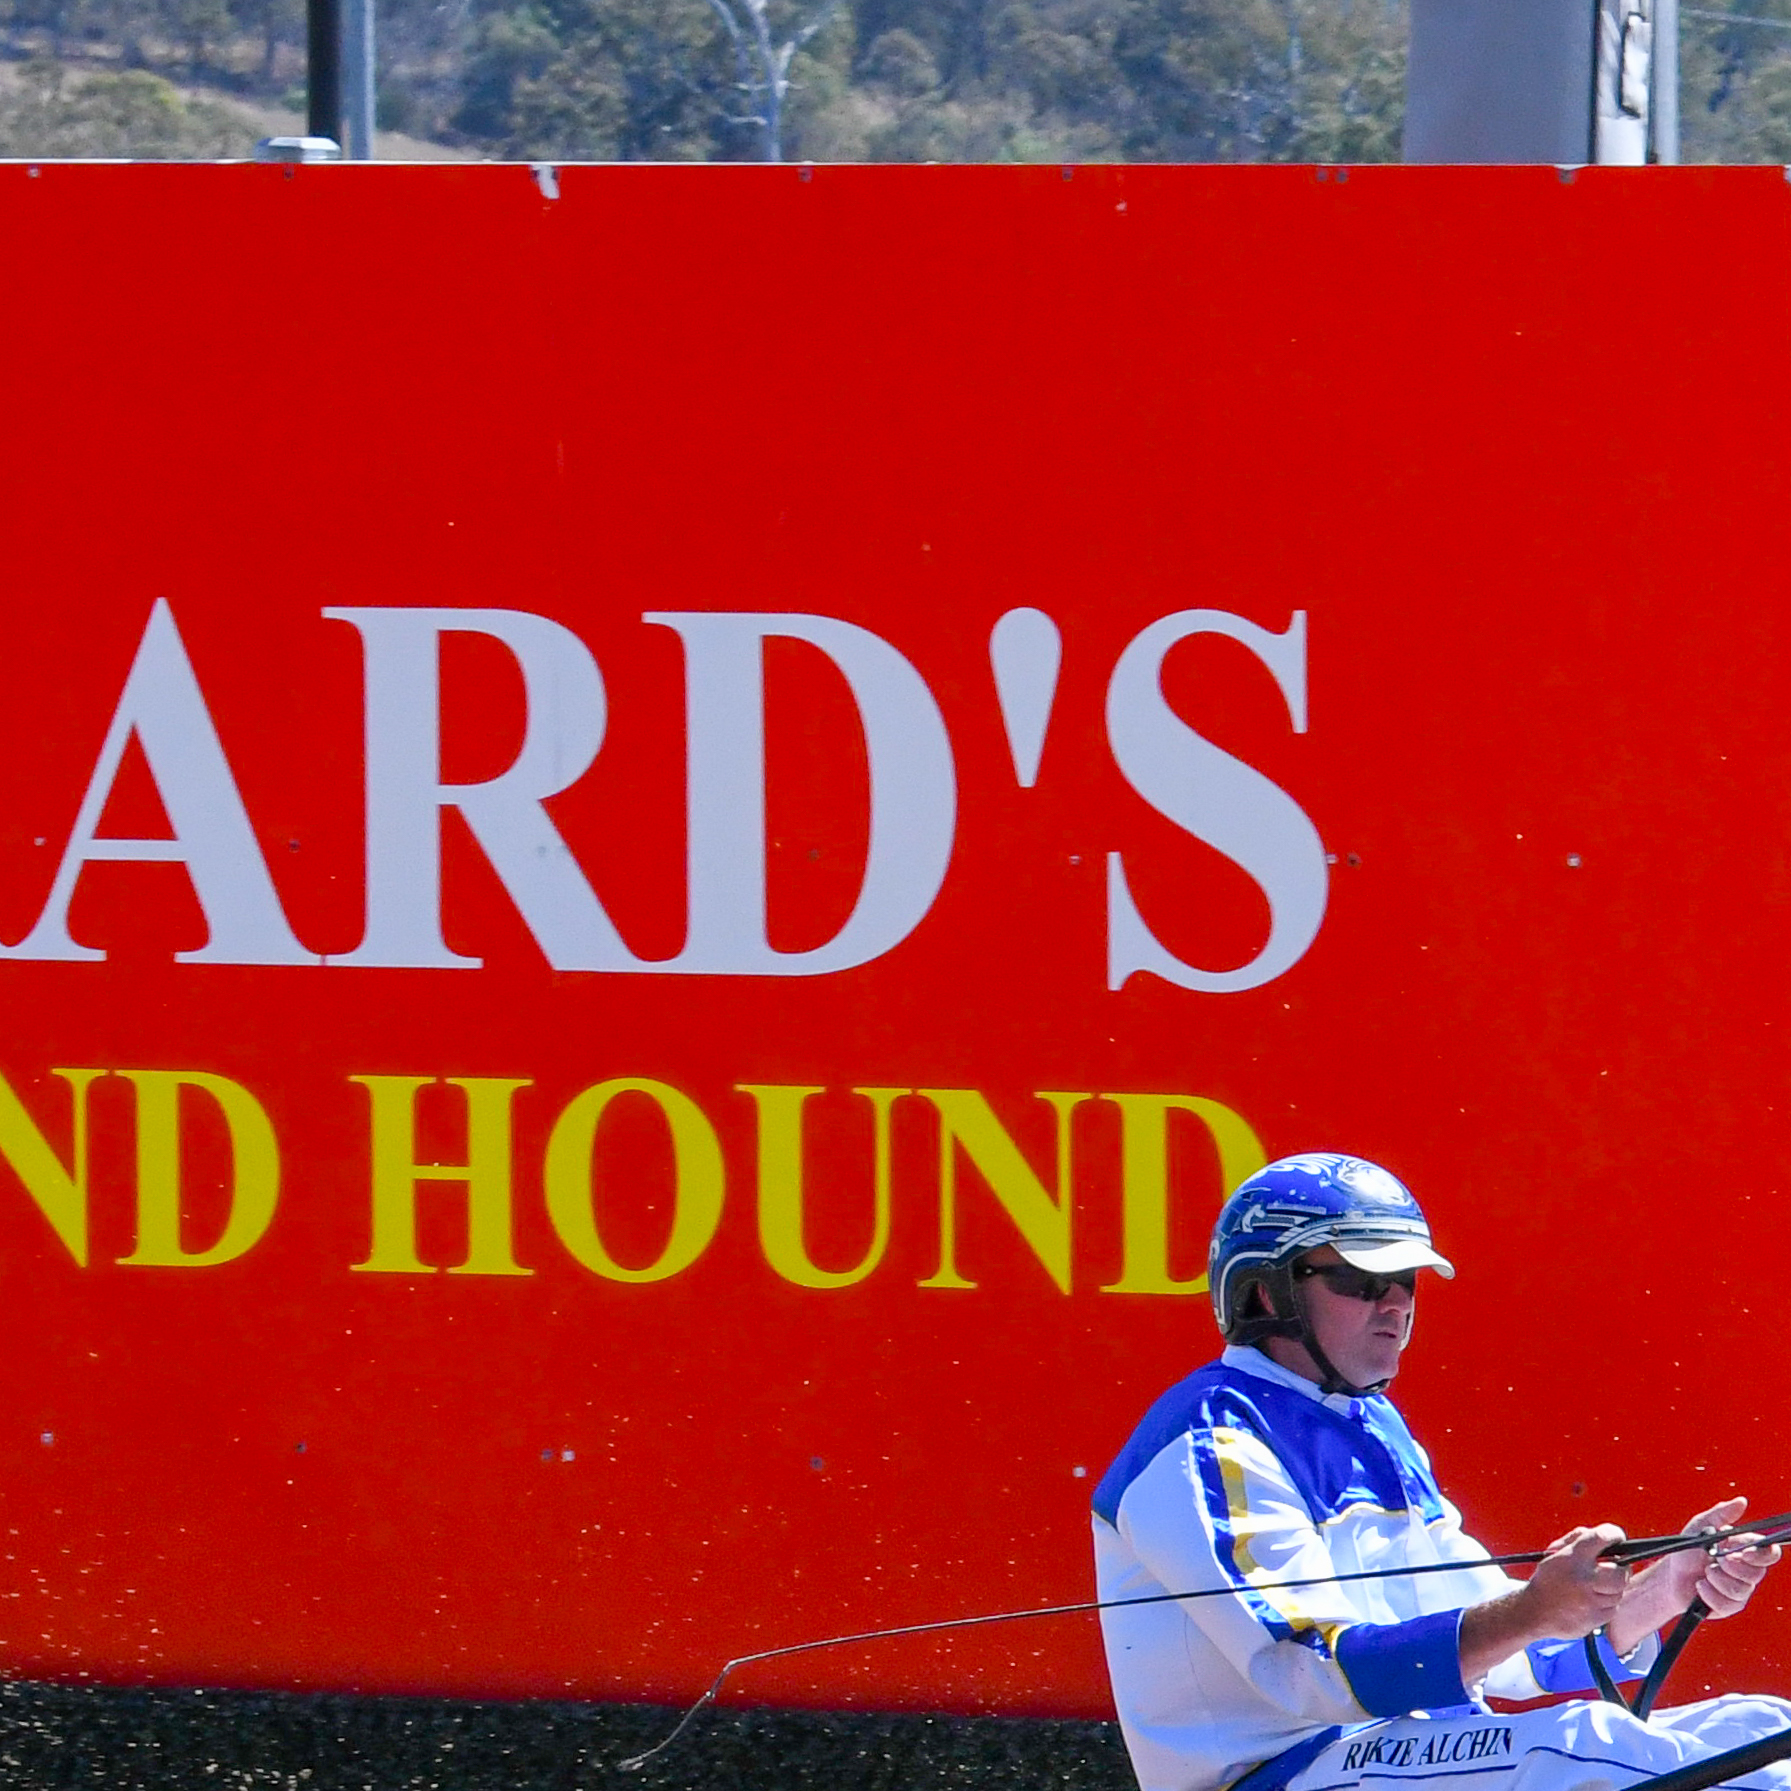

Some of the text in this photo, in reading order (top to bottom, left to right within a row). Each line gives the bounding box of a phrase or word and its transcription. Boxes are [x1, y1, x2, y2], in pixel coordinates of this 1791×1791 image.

[0, 598, 1328, 993] ARD'S
[348, 1076, 1266, 1296] HOUND
[1418, 1727, 1512, 1766] ALCHIN
